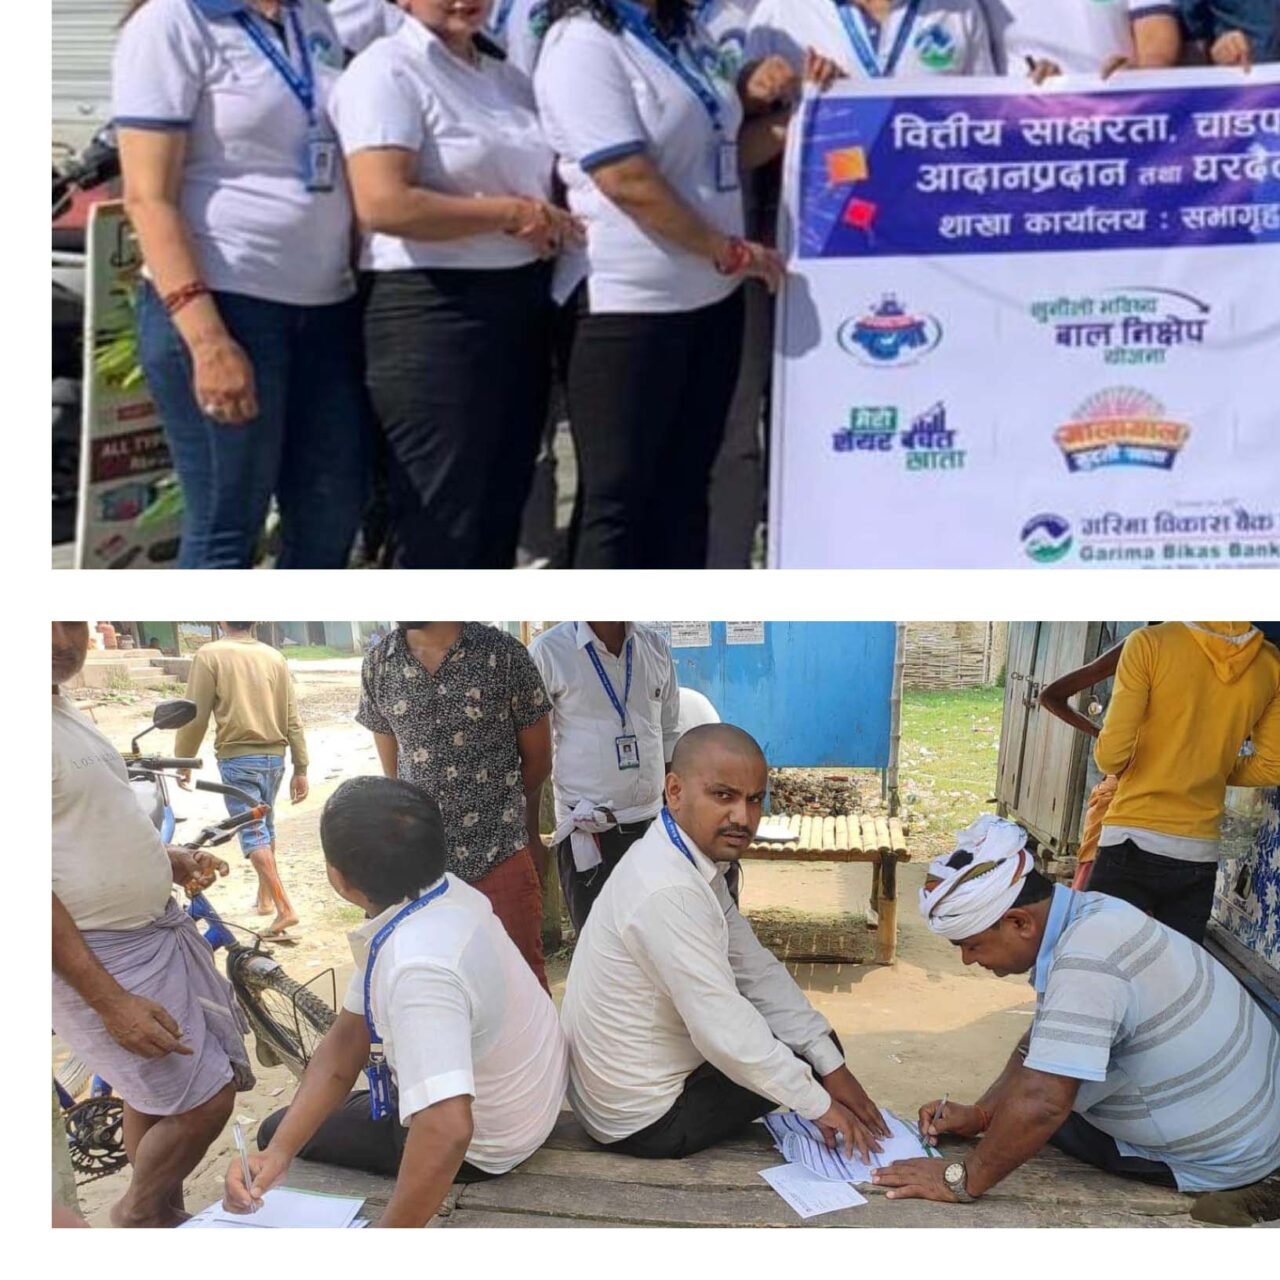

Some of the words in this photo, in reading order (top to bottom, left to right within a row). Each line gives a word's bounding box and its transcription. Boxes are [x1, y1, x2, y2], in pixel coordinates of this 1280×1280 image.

[892, 111, 1004, 149] वित्तीय
[916, 157, 1128, 194] आदानप्रदान
[1138, 166, 1182, 186] तथा
[938, 212, 1012, 238] शाखा
[1024, 205, 1147, 234] कार्यालय
[1055, 323, 1115, 347] बाल
[1121, 315, 1208, 347] निक्षेप
[1080, 511, 1147, 535] गरिमा
[1154, 510, 1230, 534] विकास
[1079, 545, 1155, 563] Garima
[1163, 543, 1221, 560] Bikas
[1229, 542, 1280, 559] Bank
